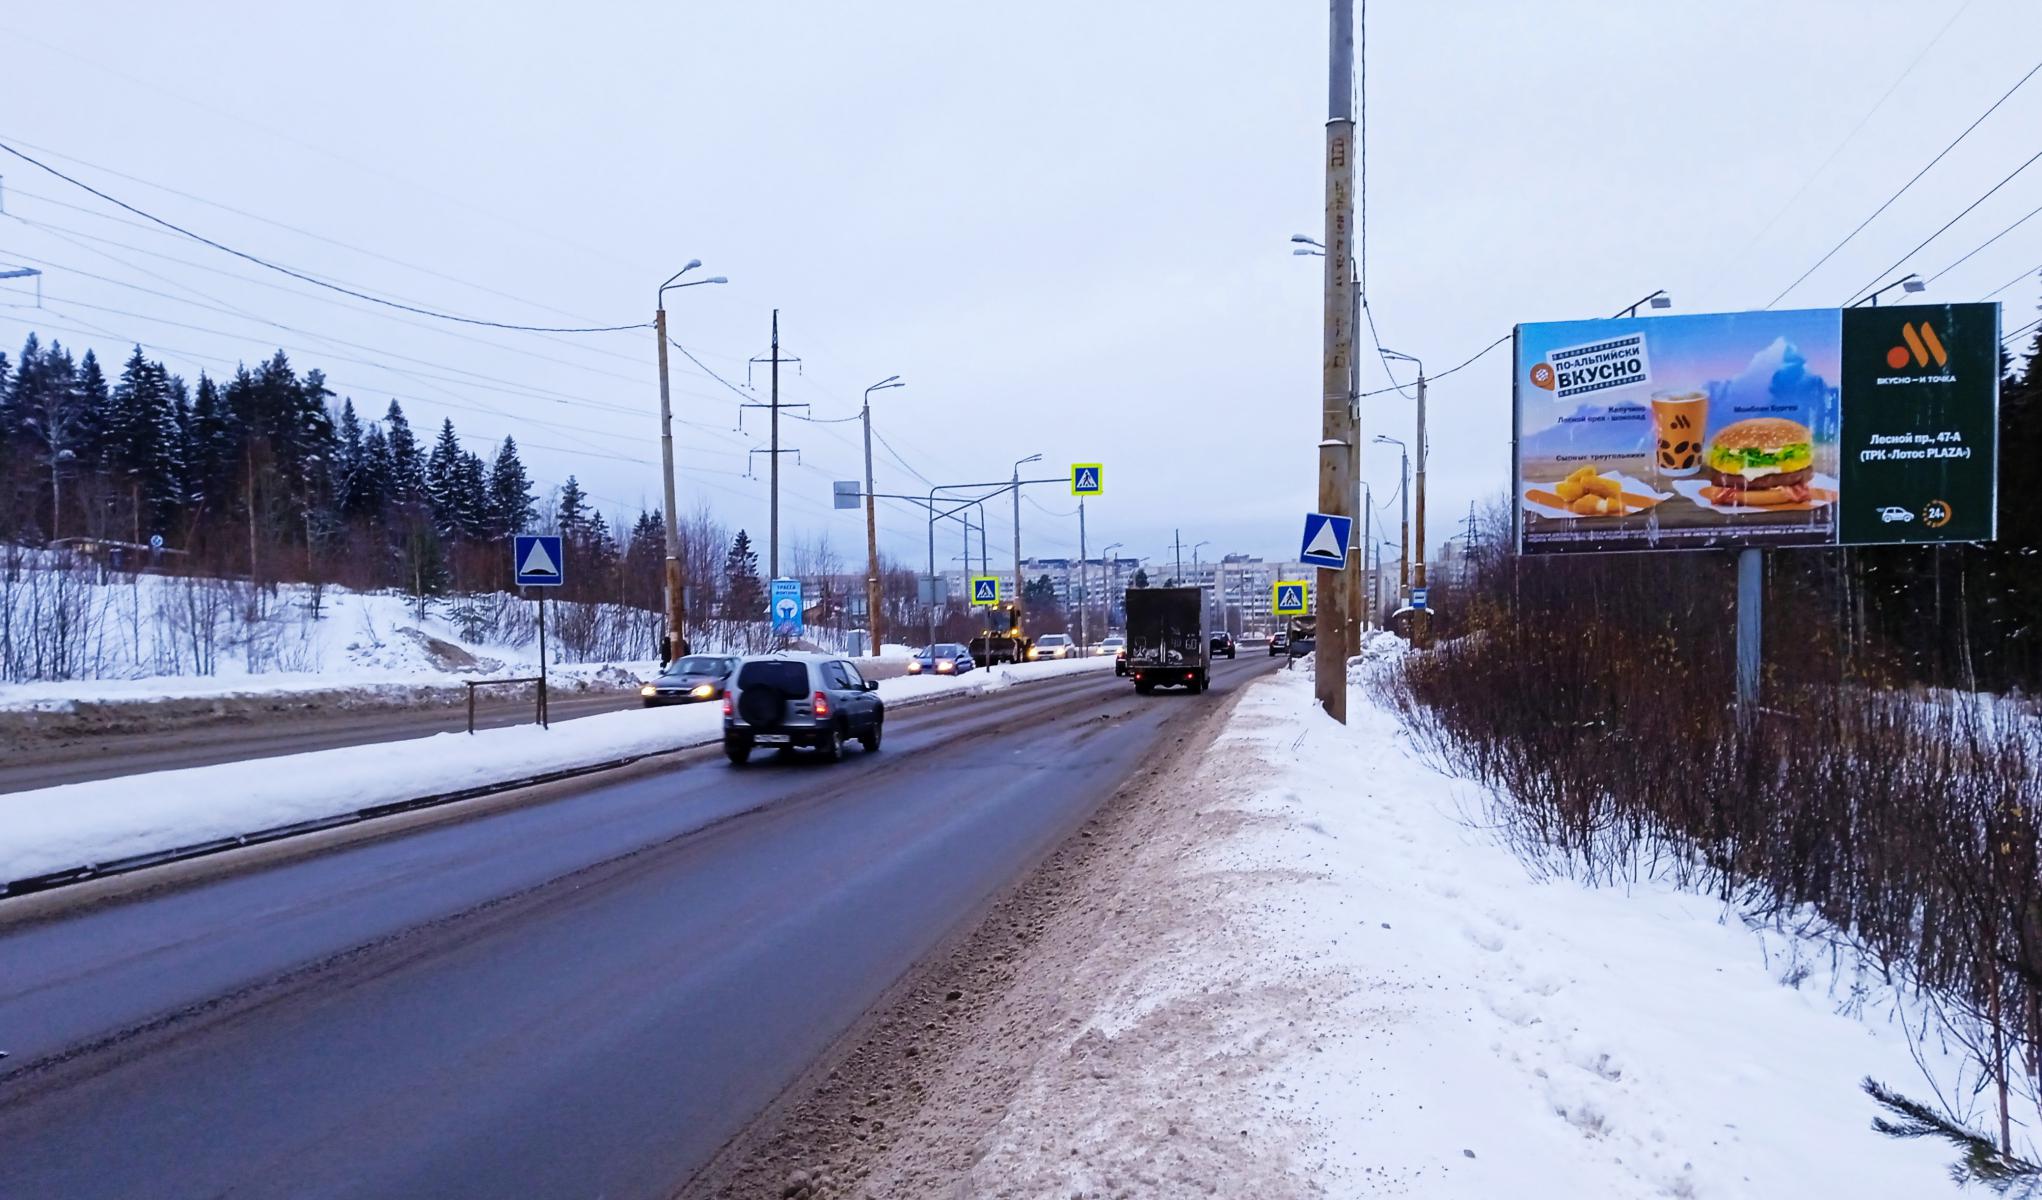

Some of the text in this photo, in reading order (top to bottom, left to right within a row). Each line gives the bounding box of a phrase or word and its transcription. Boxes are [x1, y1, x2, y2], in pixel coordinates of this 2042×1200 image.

[1556, 347, 1639, 371] ПО-АЛЬПИЙСКИ
[1558, 358, 1641, 388] ВКУСНО
[1876, 377, 1911, 385] ВКУСНО
[1919, 376, 1927, 384] И
[1928, 375, 1957, 383] ТОЧКА
[1870, 432, 1961, 445] Лесной пр., 47-А
[1860, 450, 1886, 462] (ТРК
